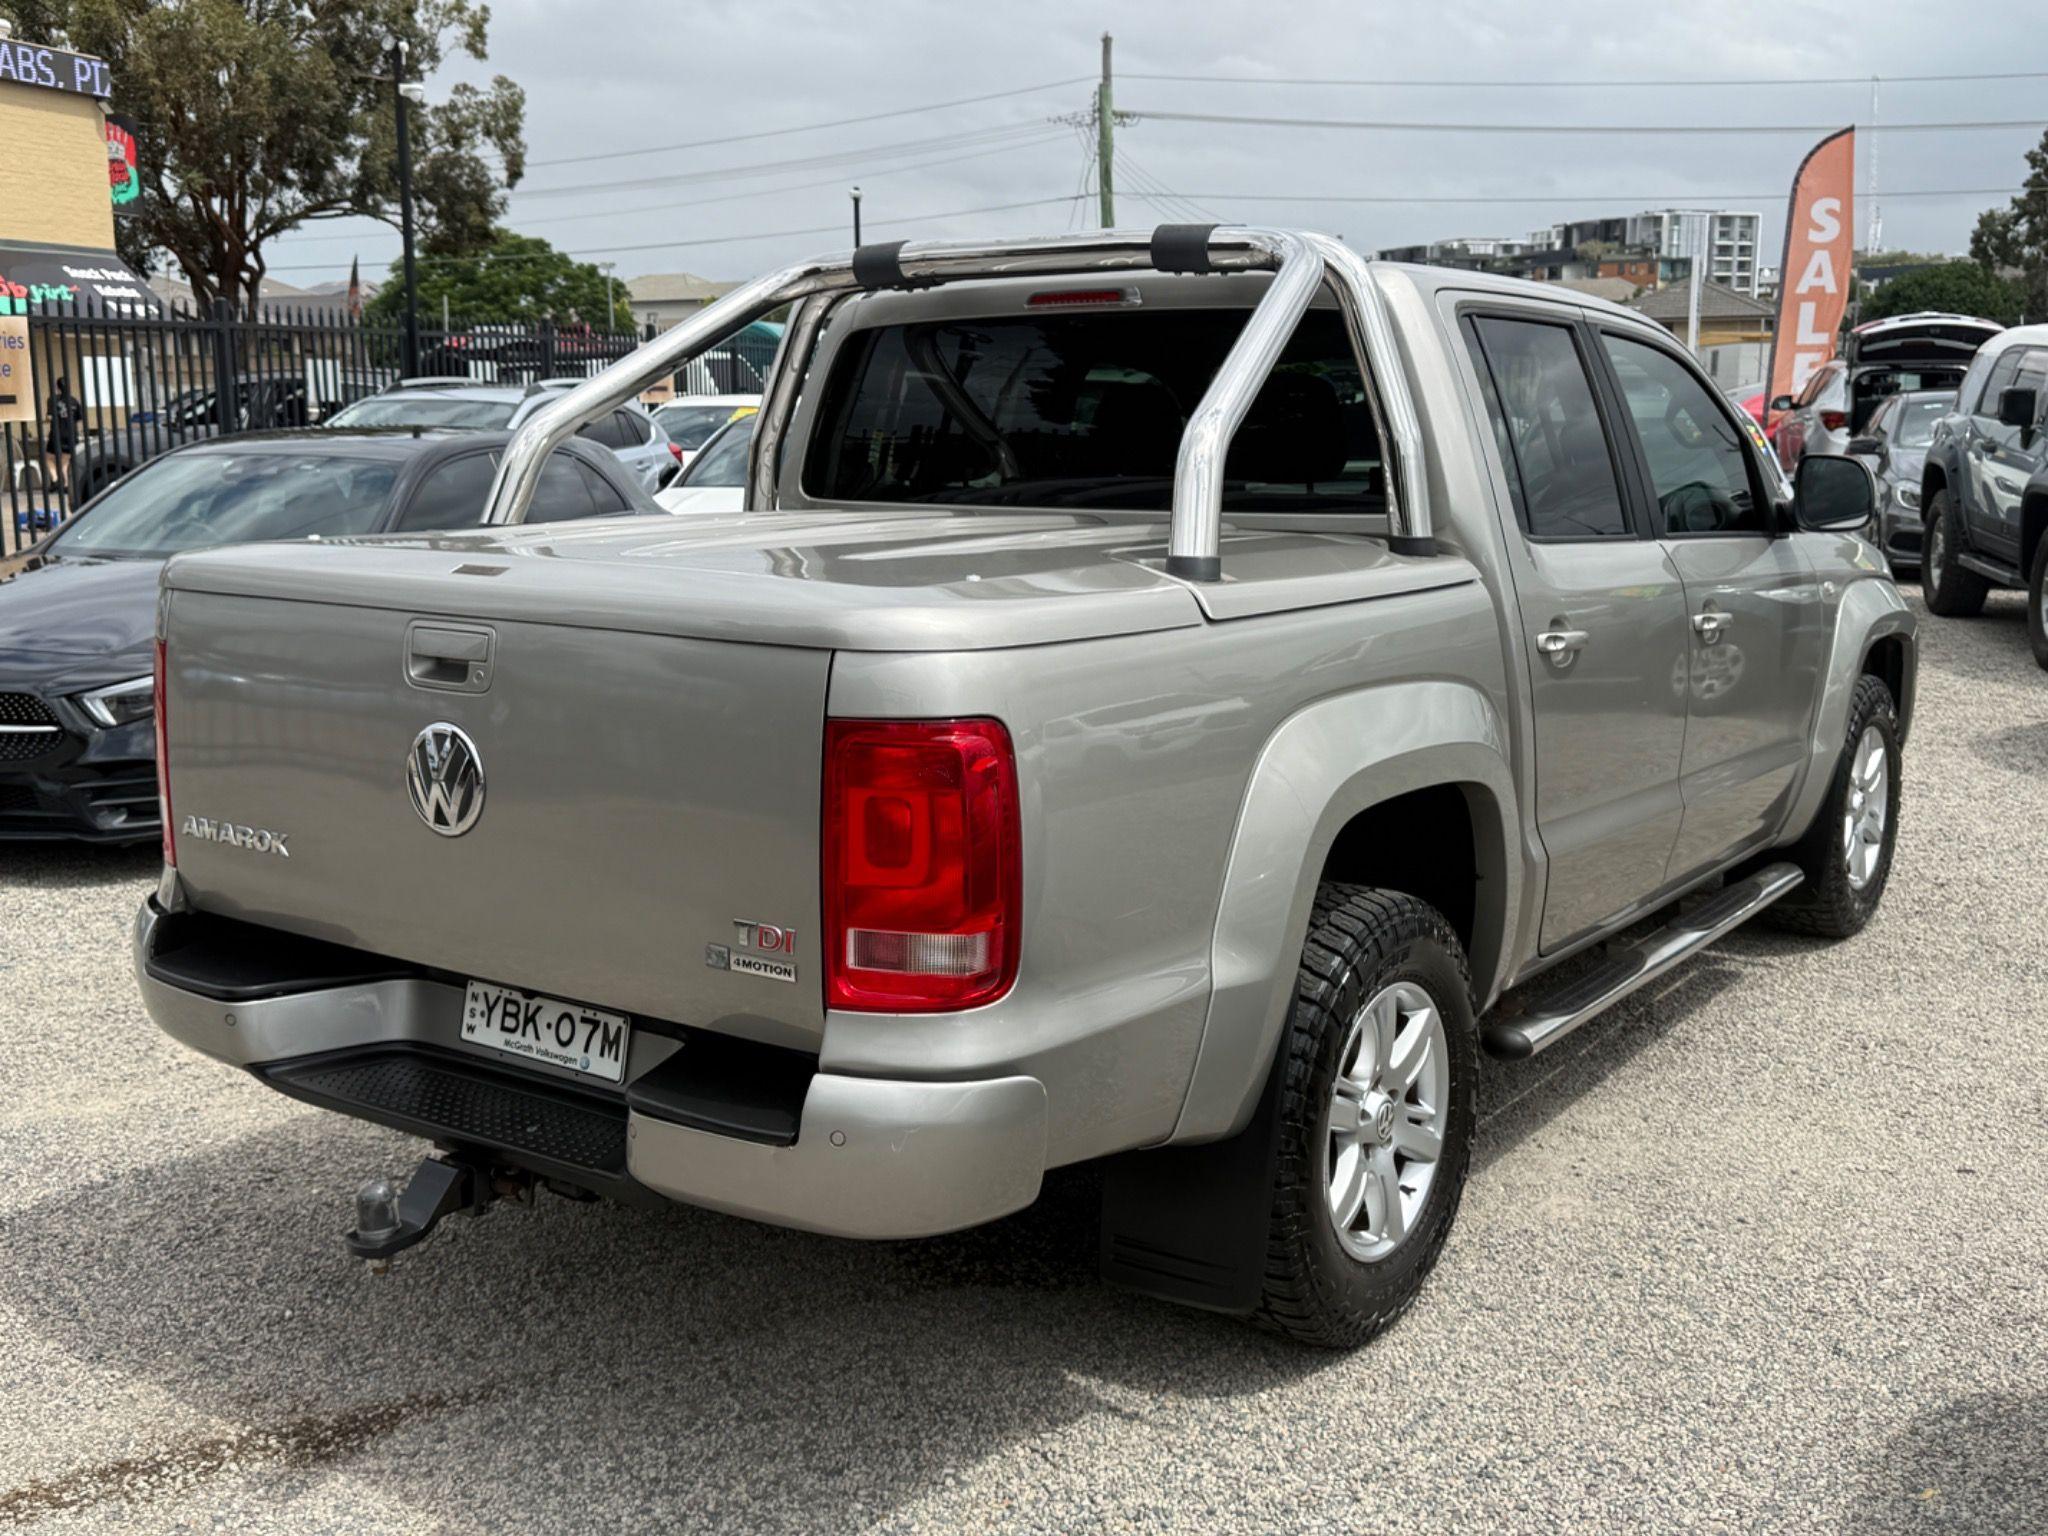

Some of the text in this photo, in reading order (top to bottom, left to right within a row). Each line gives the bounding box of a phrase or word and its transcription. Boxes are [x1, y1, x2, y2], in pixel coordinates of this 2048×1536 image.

[182, 814, 290, 858] AMAROK
[733, 918, 797, 955] TDI
[734, 957, 793, 978] 4MOTION
[535, 1046, 579, 1066] Volkswagen
